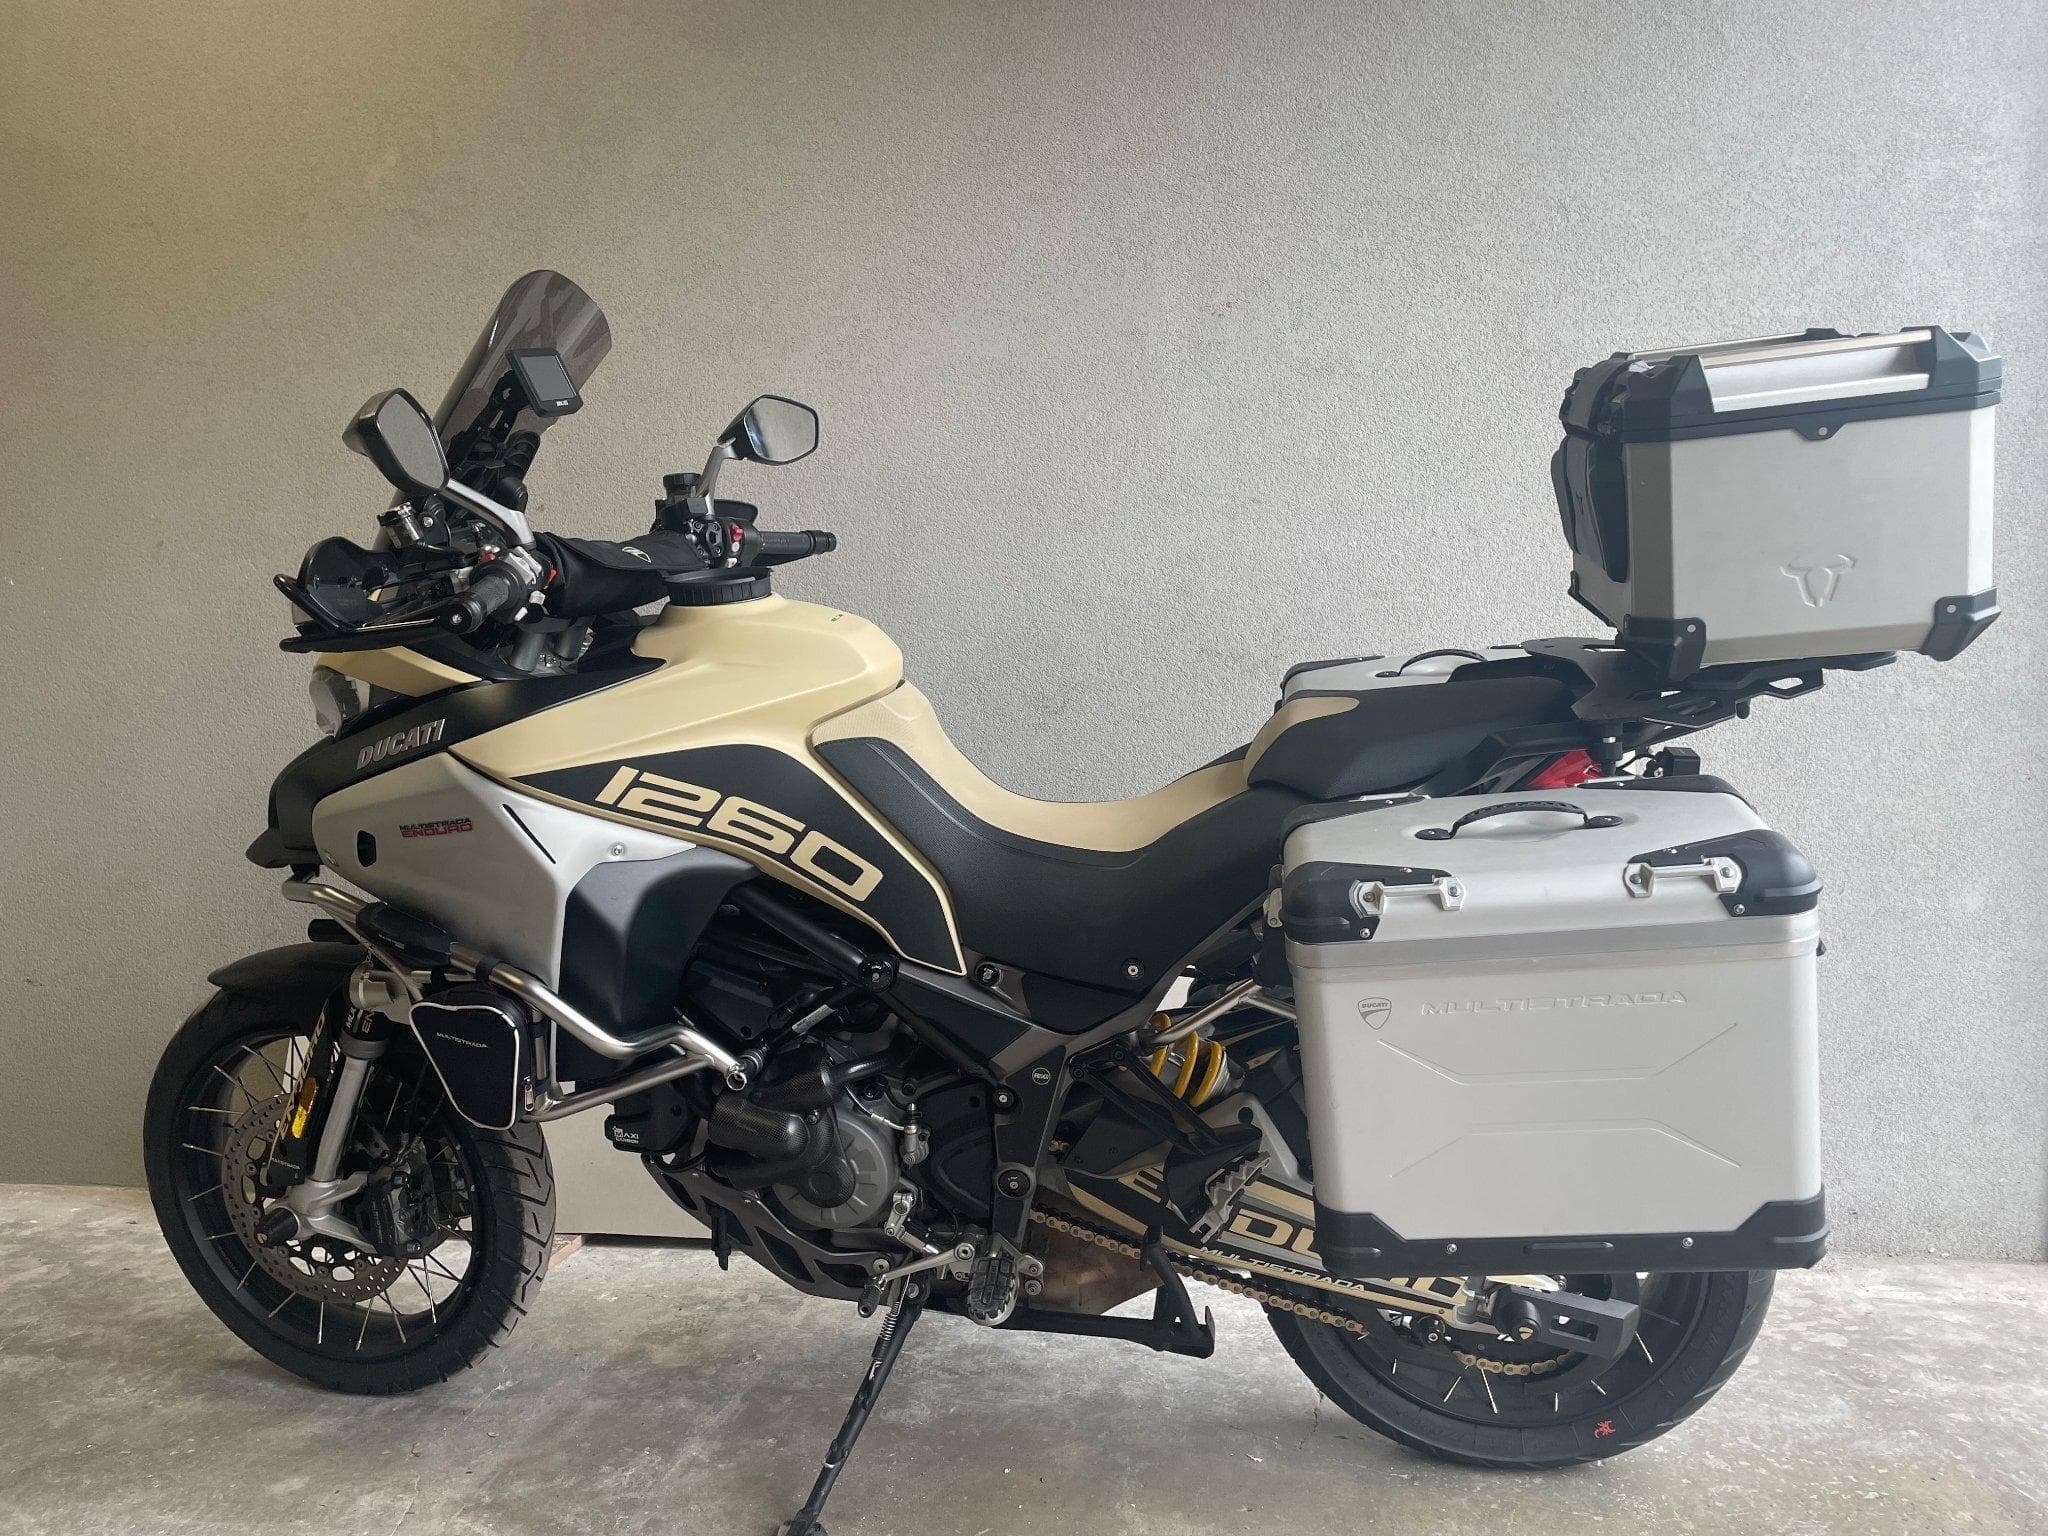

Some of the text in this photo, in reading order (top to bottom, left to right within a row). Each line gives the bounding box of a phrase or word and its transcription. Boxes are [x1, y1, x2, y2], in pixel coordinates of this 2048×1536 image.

[357, 718, 446, 769] DUCATI
[400, 822, 473, 838] ENDURO
[594, 765, 884, 902] 1260
[1420, 990, 1689, 1016] MULTISTRADA
[1200, 1246, 1366, 1292] MULTISTRADA
